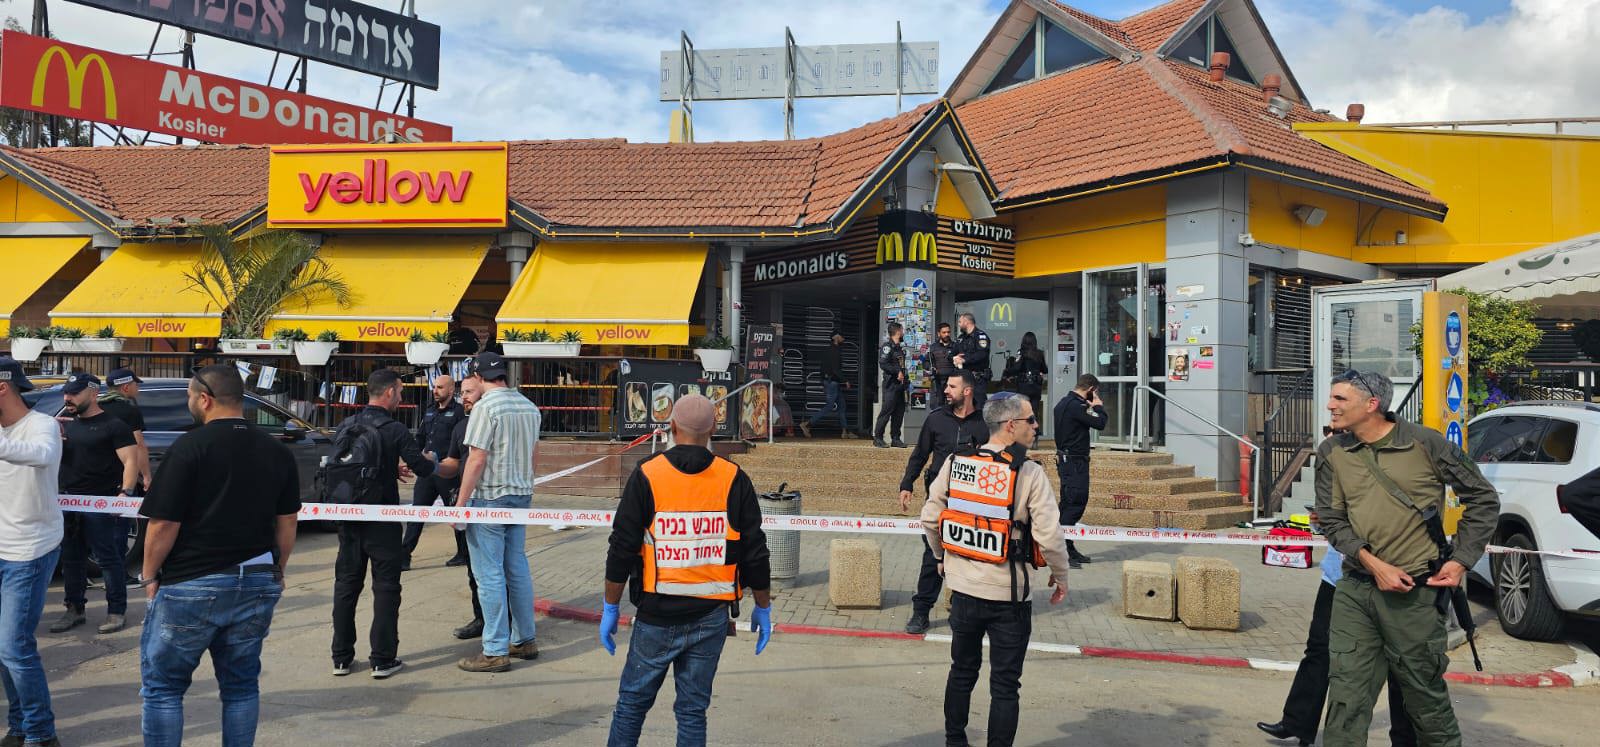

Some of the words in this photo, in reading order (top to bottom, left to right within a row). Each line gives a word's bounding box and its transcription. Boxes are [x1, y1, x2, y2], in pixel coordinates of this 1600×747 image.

[137, 0, 286, 39] אספ
[303, 3, 415, 71] ארומה
[158, 69, 424, 143] McDonald's
[158, 110, 227, 139] Kosher
[298, 158, 474, 212] yellow
[954, 219, 1012, 240] מקדונלד'ס
[966, 243, 993, 255] הכשר
[754, 252, 847, 282] McDonald's
[961, 254, 997, 272] Kosher
[137, 319, 186, 334] yellow
[358, 322, 410, 338] yellow
[596, 325, 651, 341] yellow
[953, 461, 976, 473] איחוד
[951, 471, 976, 483] הצלה
[111, 501, 141, 509] ישרא
[657, 516, 687, 535] בכיר
[692, 516, 725, 535] חובש
[761, 517, 777, 525] עבר
[948, 523, 997, 552] חובש
[657, 545, 690, 561] הצלה
[693, 545, 723, 559] איחוד
